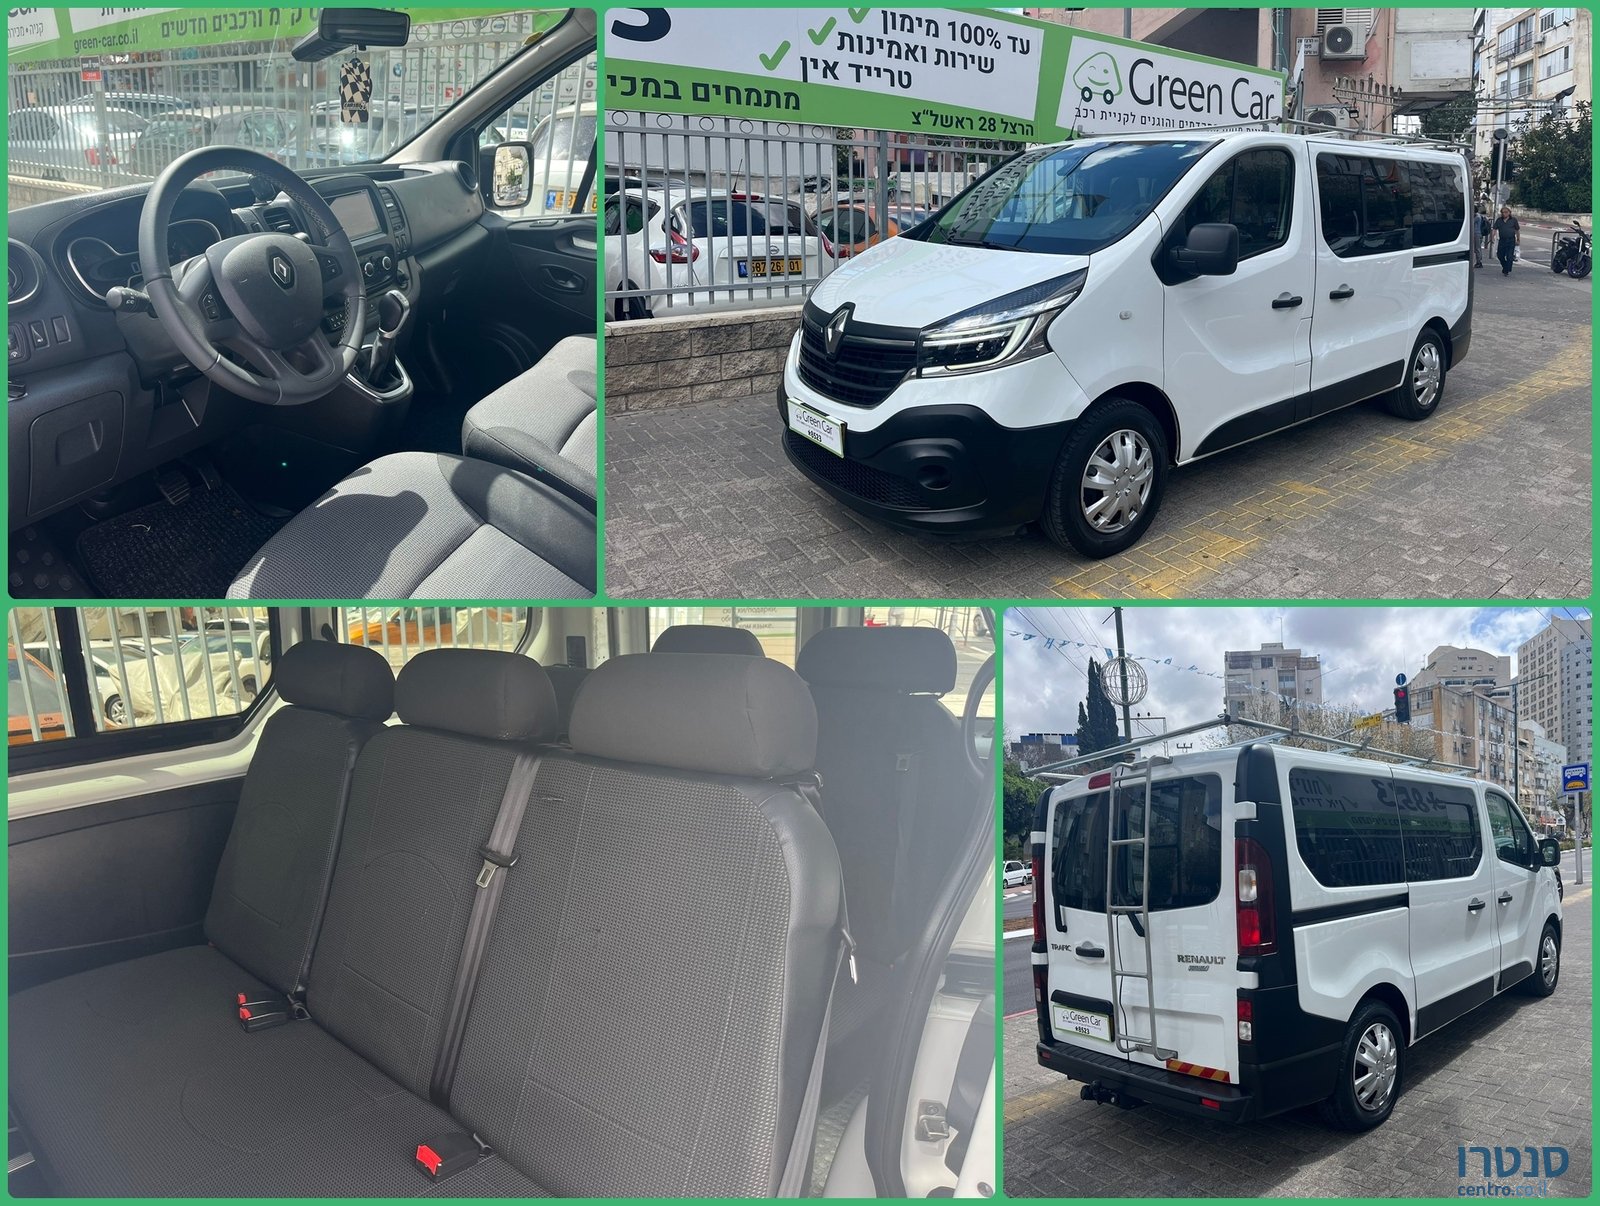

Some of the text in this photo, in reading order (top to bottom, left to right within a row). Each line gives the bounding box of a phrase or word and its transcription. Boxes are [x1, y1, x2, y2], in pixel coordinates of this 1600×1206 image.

[161, 17, 207, 38] חדשים
[212, 9, 263, 33] ורכבים
[881, 9, 1031, 55] עד 100% מימון
[837, 31, 995, 74] שירות ואמינות
[800, 56, 913, 89] טרייד אין
[692, 82, 801, 111] מתמחים
[1129, 58, 1275, 121] Green Car
[1075, 107, 1096, 119] רכב
[1100, 109, 1136, 126] לקניית
[1140, 115, 1175, 128] והוגנים
[978, 116, 997, 133] 28
[1000, 118, 1034, 137] הרצל
[803, 410, 822, 430] Green
[821, 420, 833, 434] Car
[1177, 954, 1226, 965] RENAULT
[1070, 1010, 1090, 1024] Green
[1090, 1015, 1101, 1027] Car
